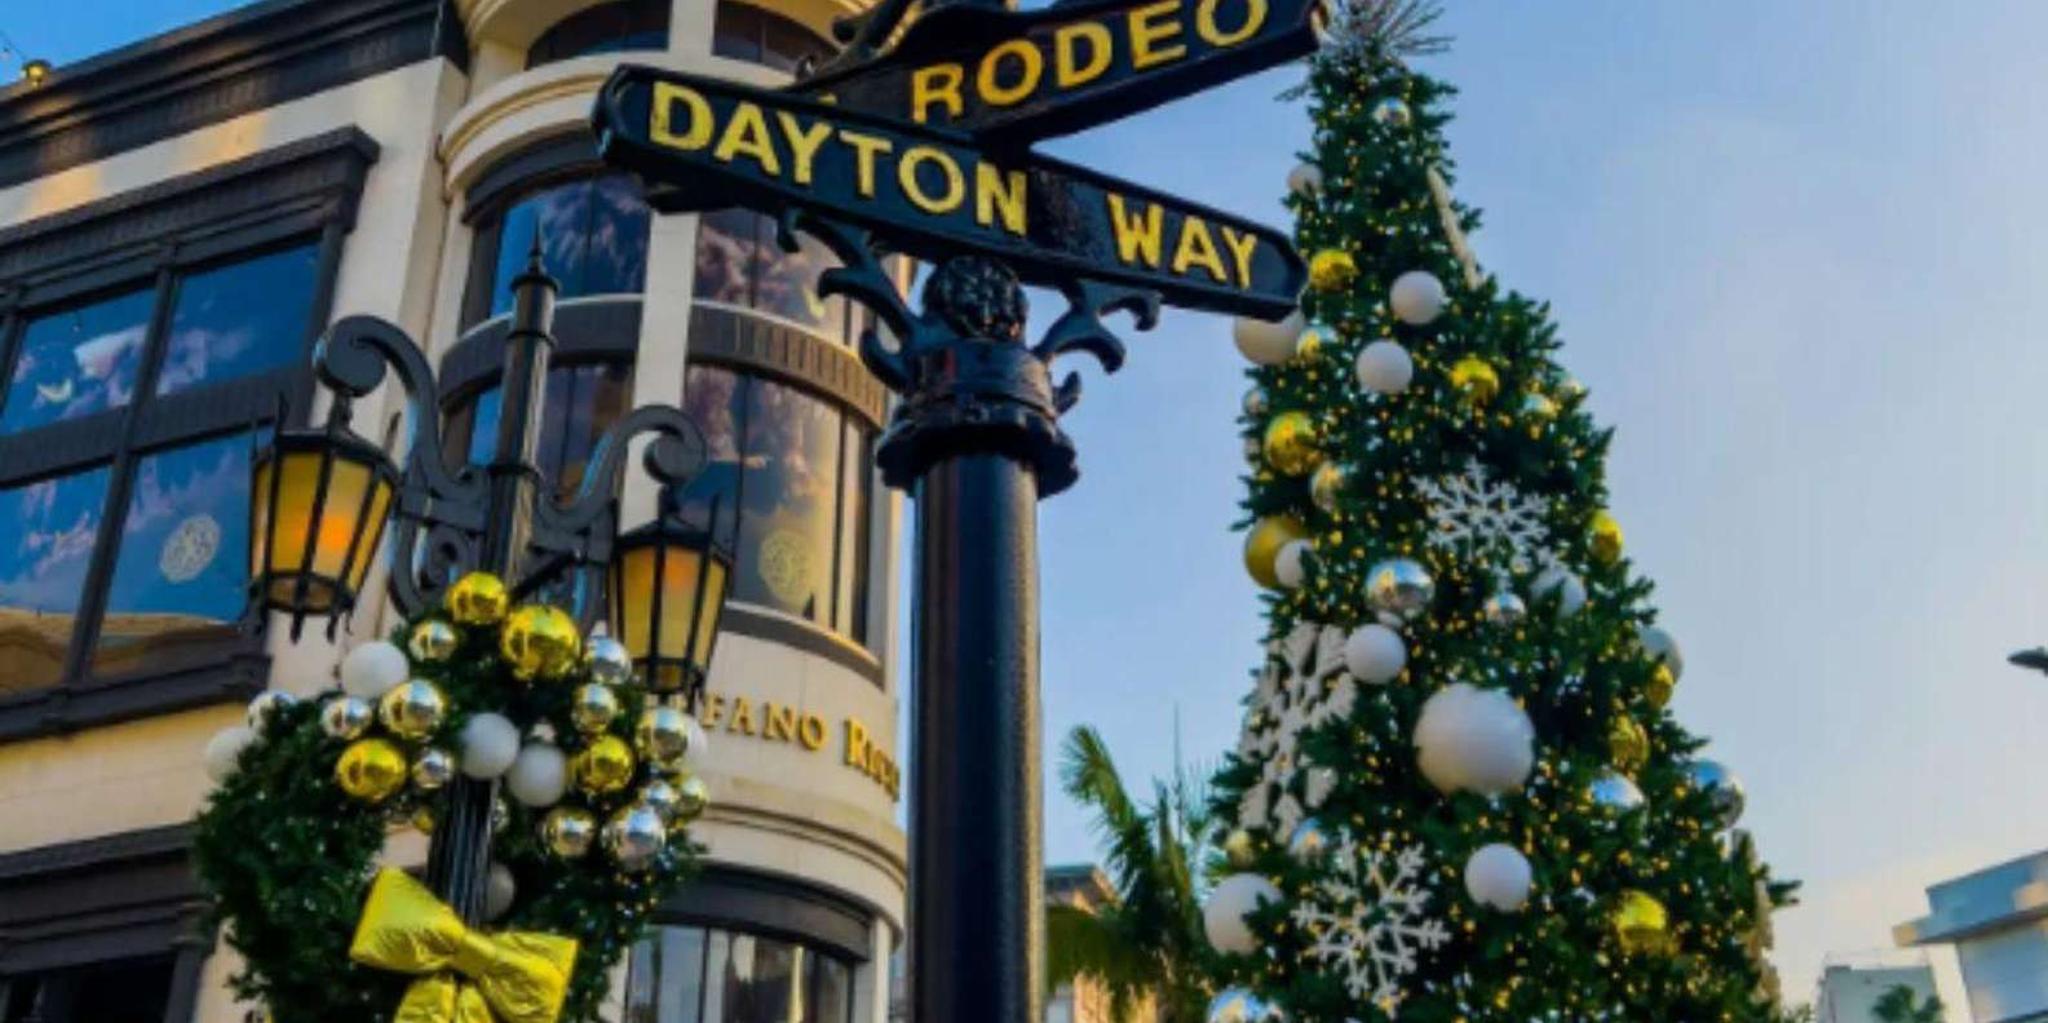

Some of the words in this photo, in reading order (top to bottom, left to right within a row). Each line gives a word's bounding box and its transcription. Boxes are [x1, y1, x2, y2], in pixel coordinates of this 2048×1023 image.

[912, 0, 1268, 124] RODEO
[649, 81, 1028, 237] DAYTON
[1107, 193, 1257, 289] WAY
